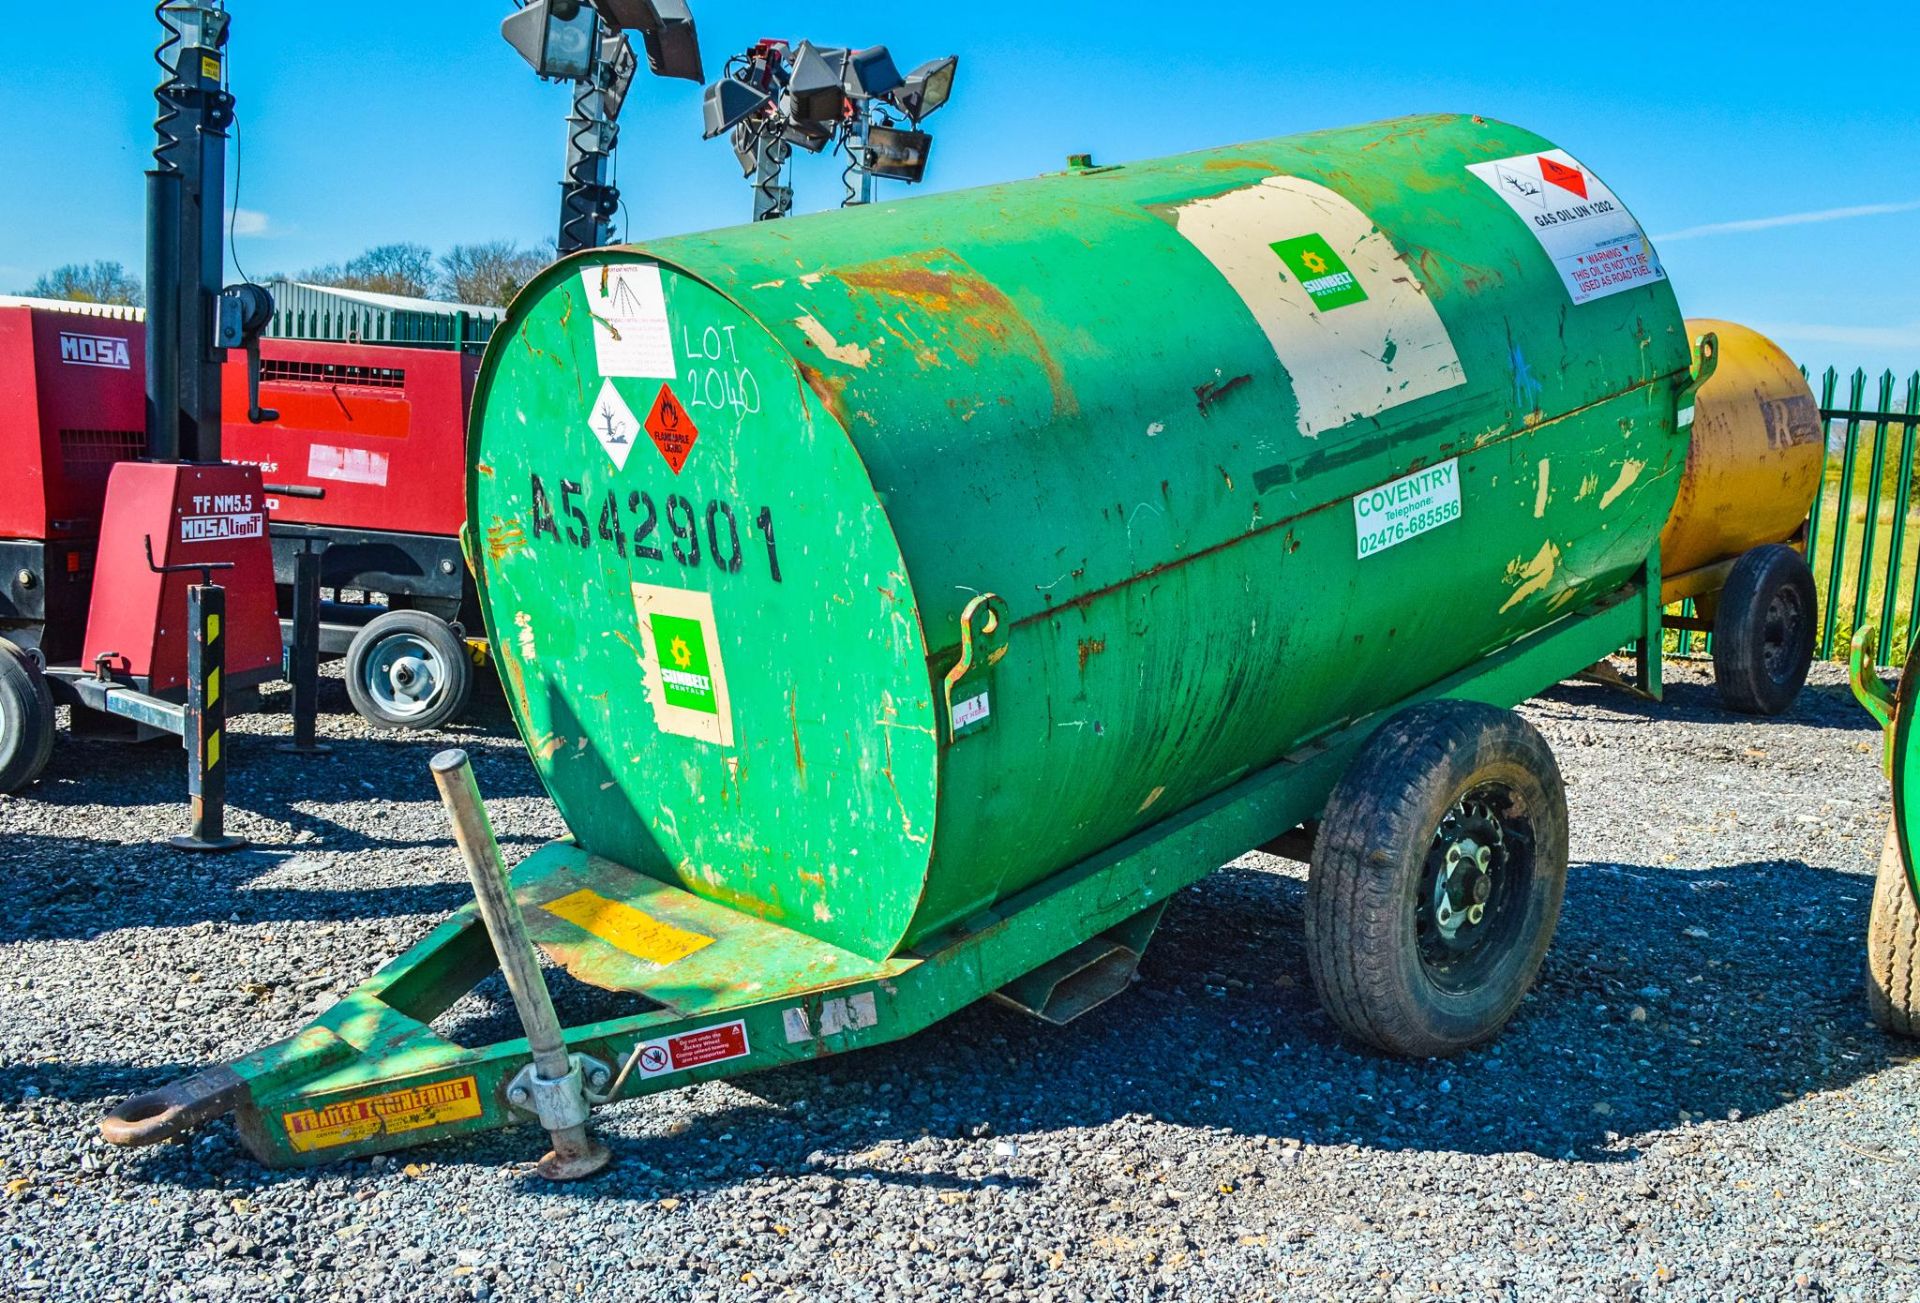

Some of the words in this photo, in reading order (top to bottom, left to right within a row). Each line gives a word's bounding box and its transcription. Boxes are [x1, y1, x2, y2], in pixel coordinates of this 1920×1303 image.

[1534, 213, 1557, 227] GAS
[1558, 209, 1576, 222] OIL
[1577, 205, 1589, 218] UN
[1590, 200, 1614, 214] 1202
[1571, 268, 1590, 281] THIS
[1590, 266, 1603, 277] OIL
[1603, 263, 1612, 273] IS
[1611, 259, 1626, 271] NOT
[1625, 256, 1637, 267] TO
[1636, 253, 1648, 263] BE
[1586, 248, 1622, 264] WARNING
[1302, 271, 1353, 294] SUNBELT
[1316, 283, 1352, 297] RENTALS
[1579, 280, 1601, 293] USED
[1602, 276, 1613, 287] AS
[1612, 271, 1632, 284] ROAD
[1632, 265, 1652, 277] FUEL
[60, 335, 131, 365] MOSA
[683, 324, 740, 363] LOT
[687, 367, 760, 417] 2040
[1358, 463, 1454, 517] COVENTRY
[193, 495, 212, 514] TF
[214, 494, 252, 513] NM5.5
[1385, 496, 1434, 521] Telephone:
[181, 518, 229, 540] MOSA
[531, 473, 782, 583] A542901
[1360, 500, 1459, 554] 02476-685556
[660, 668, 711, 691] SUNBELT
[670, 683, 705, 697] RENTALS
[955, 713, 969, 725] LIFT
[702, 1038, 720, 1047] Wheel
[300, 1105, 361, 1130] TRAILER
[367, 1083, 465, 1118] ENGINEERING
